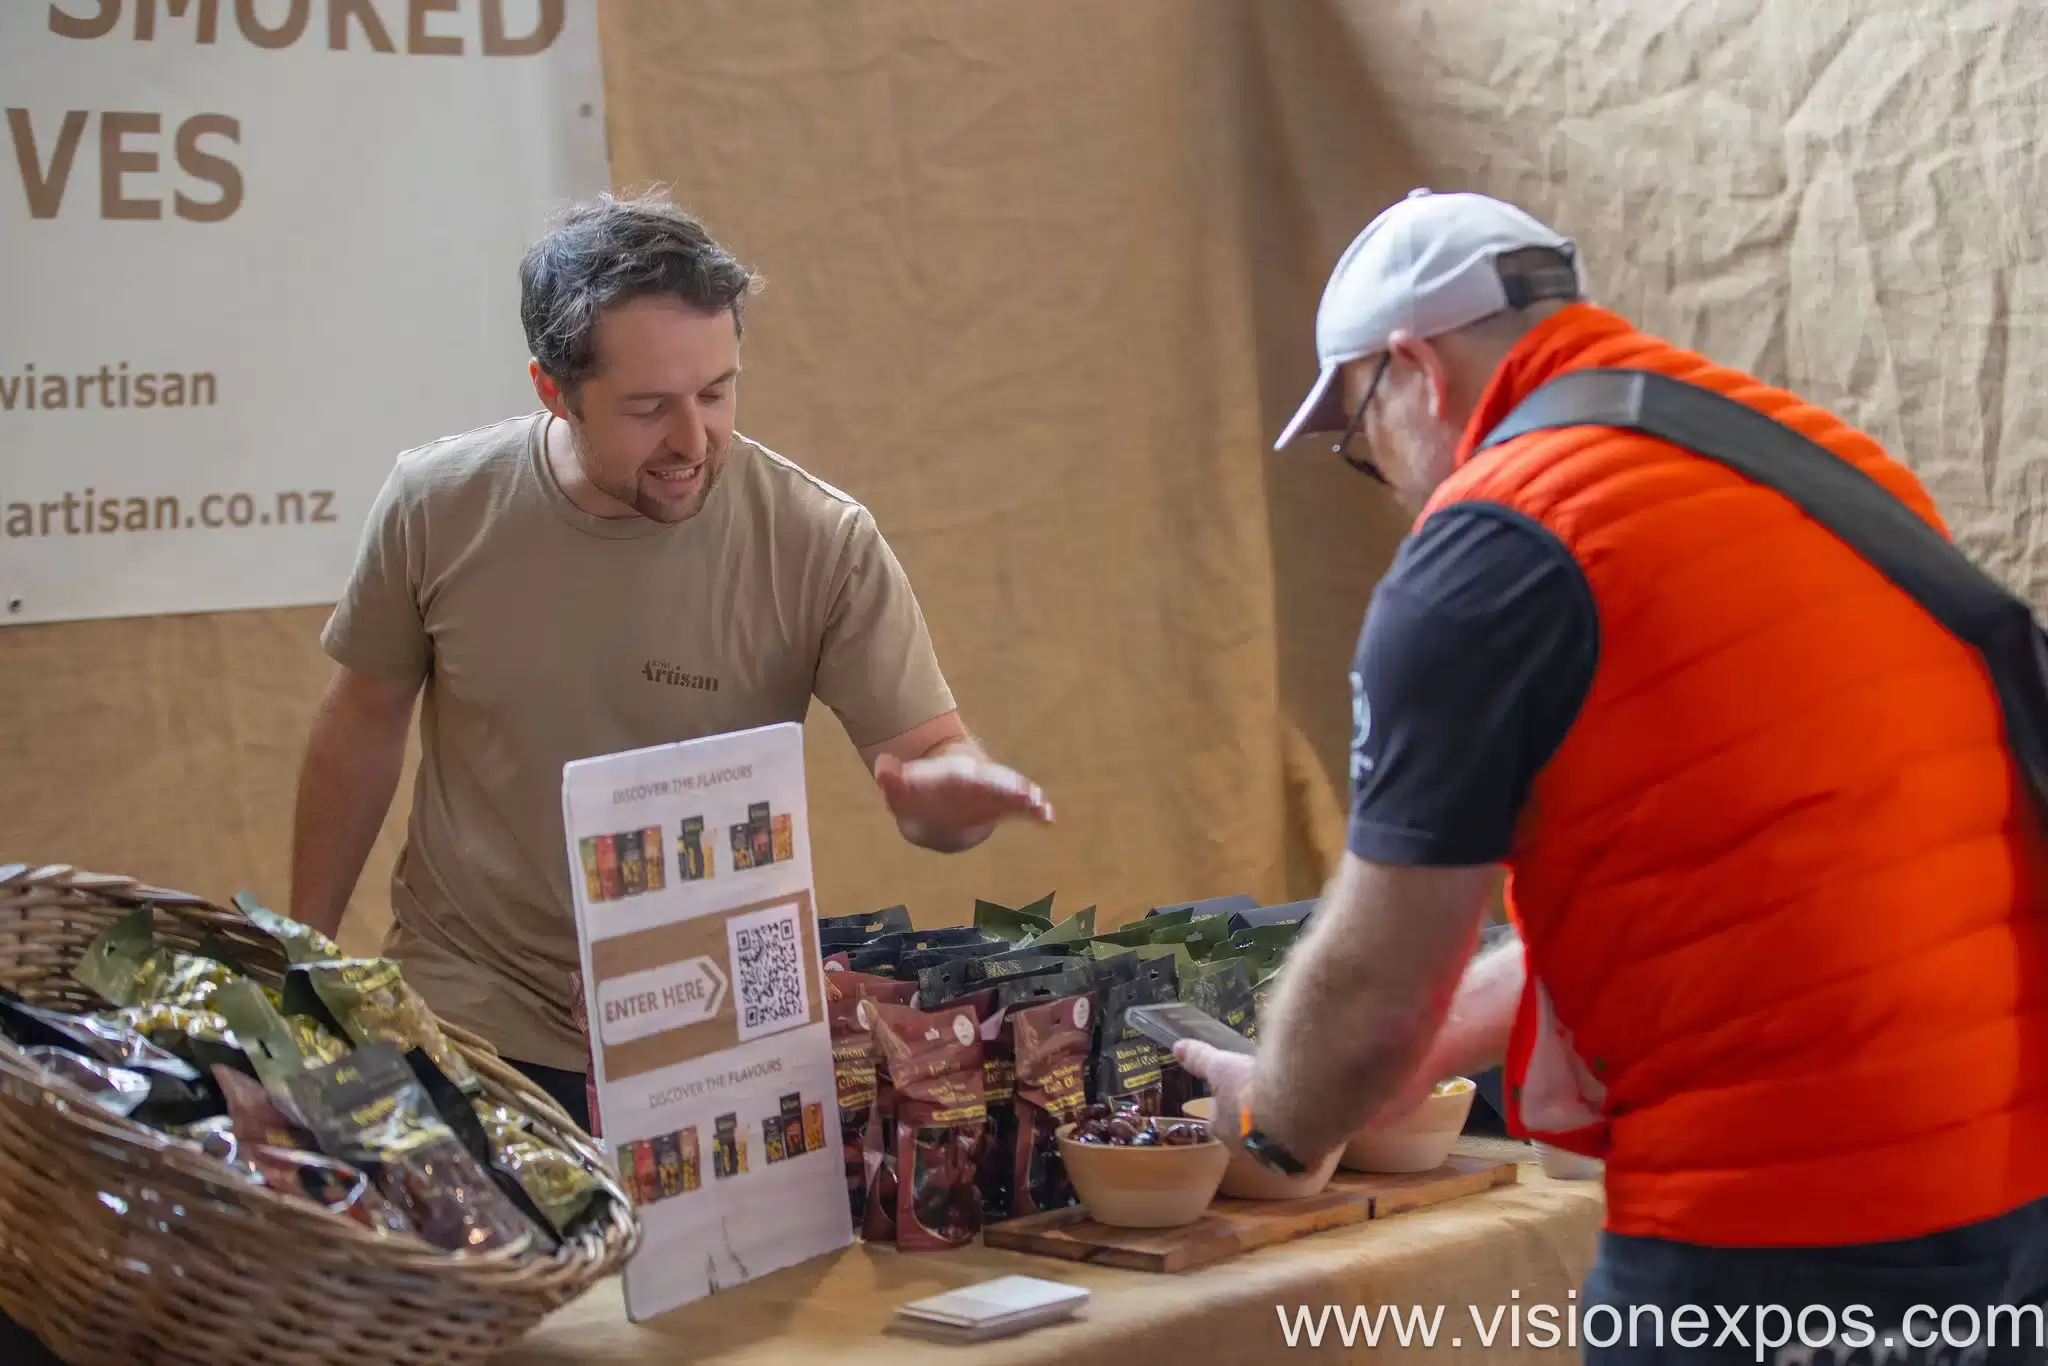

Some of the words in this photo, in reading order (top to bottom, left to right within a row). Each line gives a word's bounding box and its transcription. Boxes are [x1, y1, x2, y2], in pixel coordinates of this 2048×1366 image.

[6, 107, 246, 223] VES
[0, 487, 337, 538] artisan.co.nz
[641, 660, 719, 691] Artisan
[613, 780, 668, 804] DISCOVER
[672, 776, 694, 793] THE
[697, 764, 752, 787] FLAVOURS
[605, 991, 658, 1024] ENTER
[662, 978, 705, 1008] HERE
[648, 1080, 703, 1109] DISCOVER
[706, 1073, 726, 1092] THE
[729, 1056, 782, 1085] FLAVOURS
